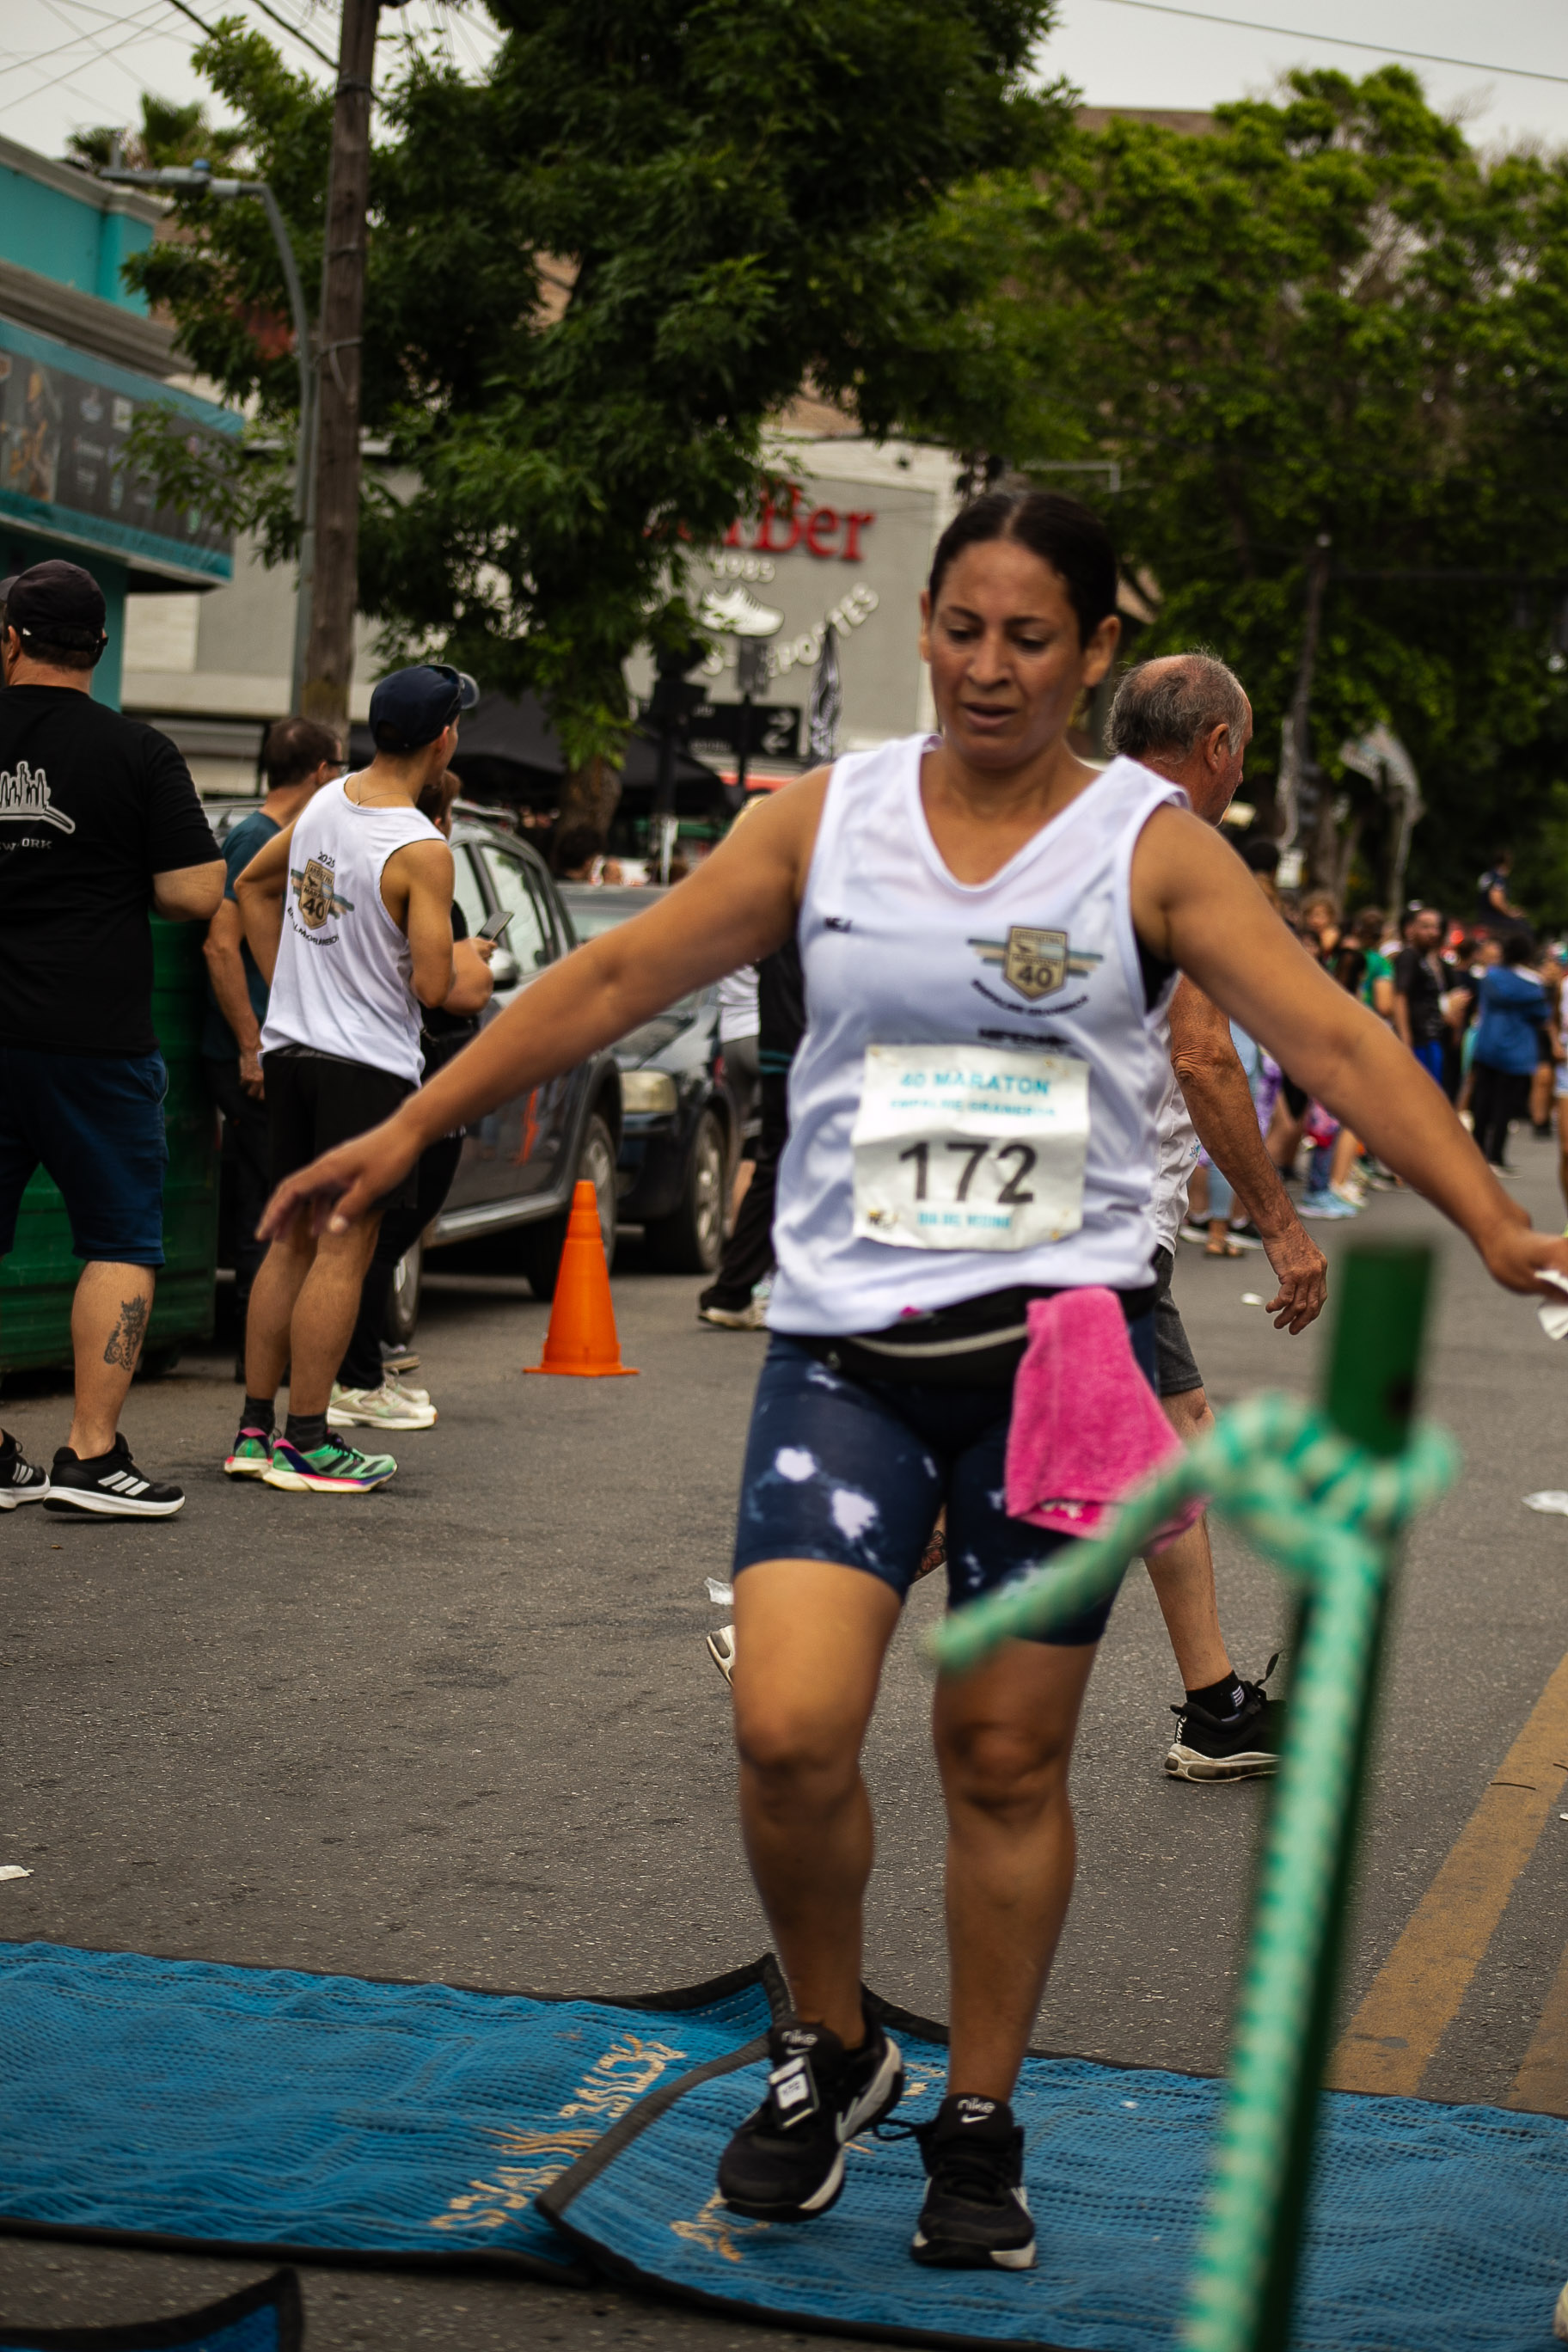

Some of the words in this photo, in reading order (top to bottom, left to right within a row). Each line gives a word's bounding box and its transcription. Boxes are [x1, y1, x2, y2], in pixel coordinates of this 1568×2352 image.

[22, 837, 52, 849] ORK
[302, 898, 325, 920] 40
[1018, 965, 1053, 988] 40
[902, 1073, 926, 1087] 40
[934, 1071, 1050, 1097] MARATON
[899, 1141, 1038, 1204] 172
[957, 2098, 995, 2113] nike
